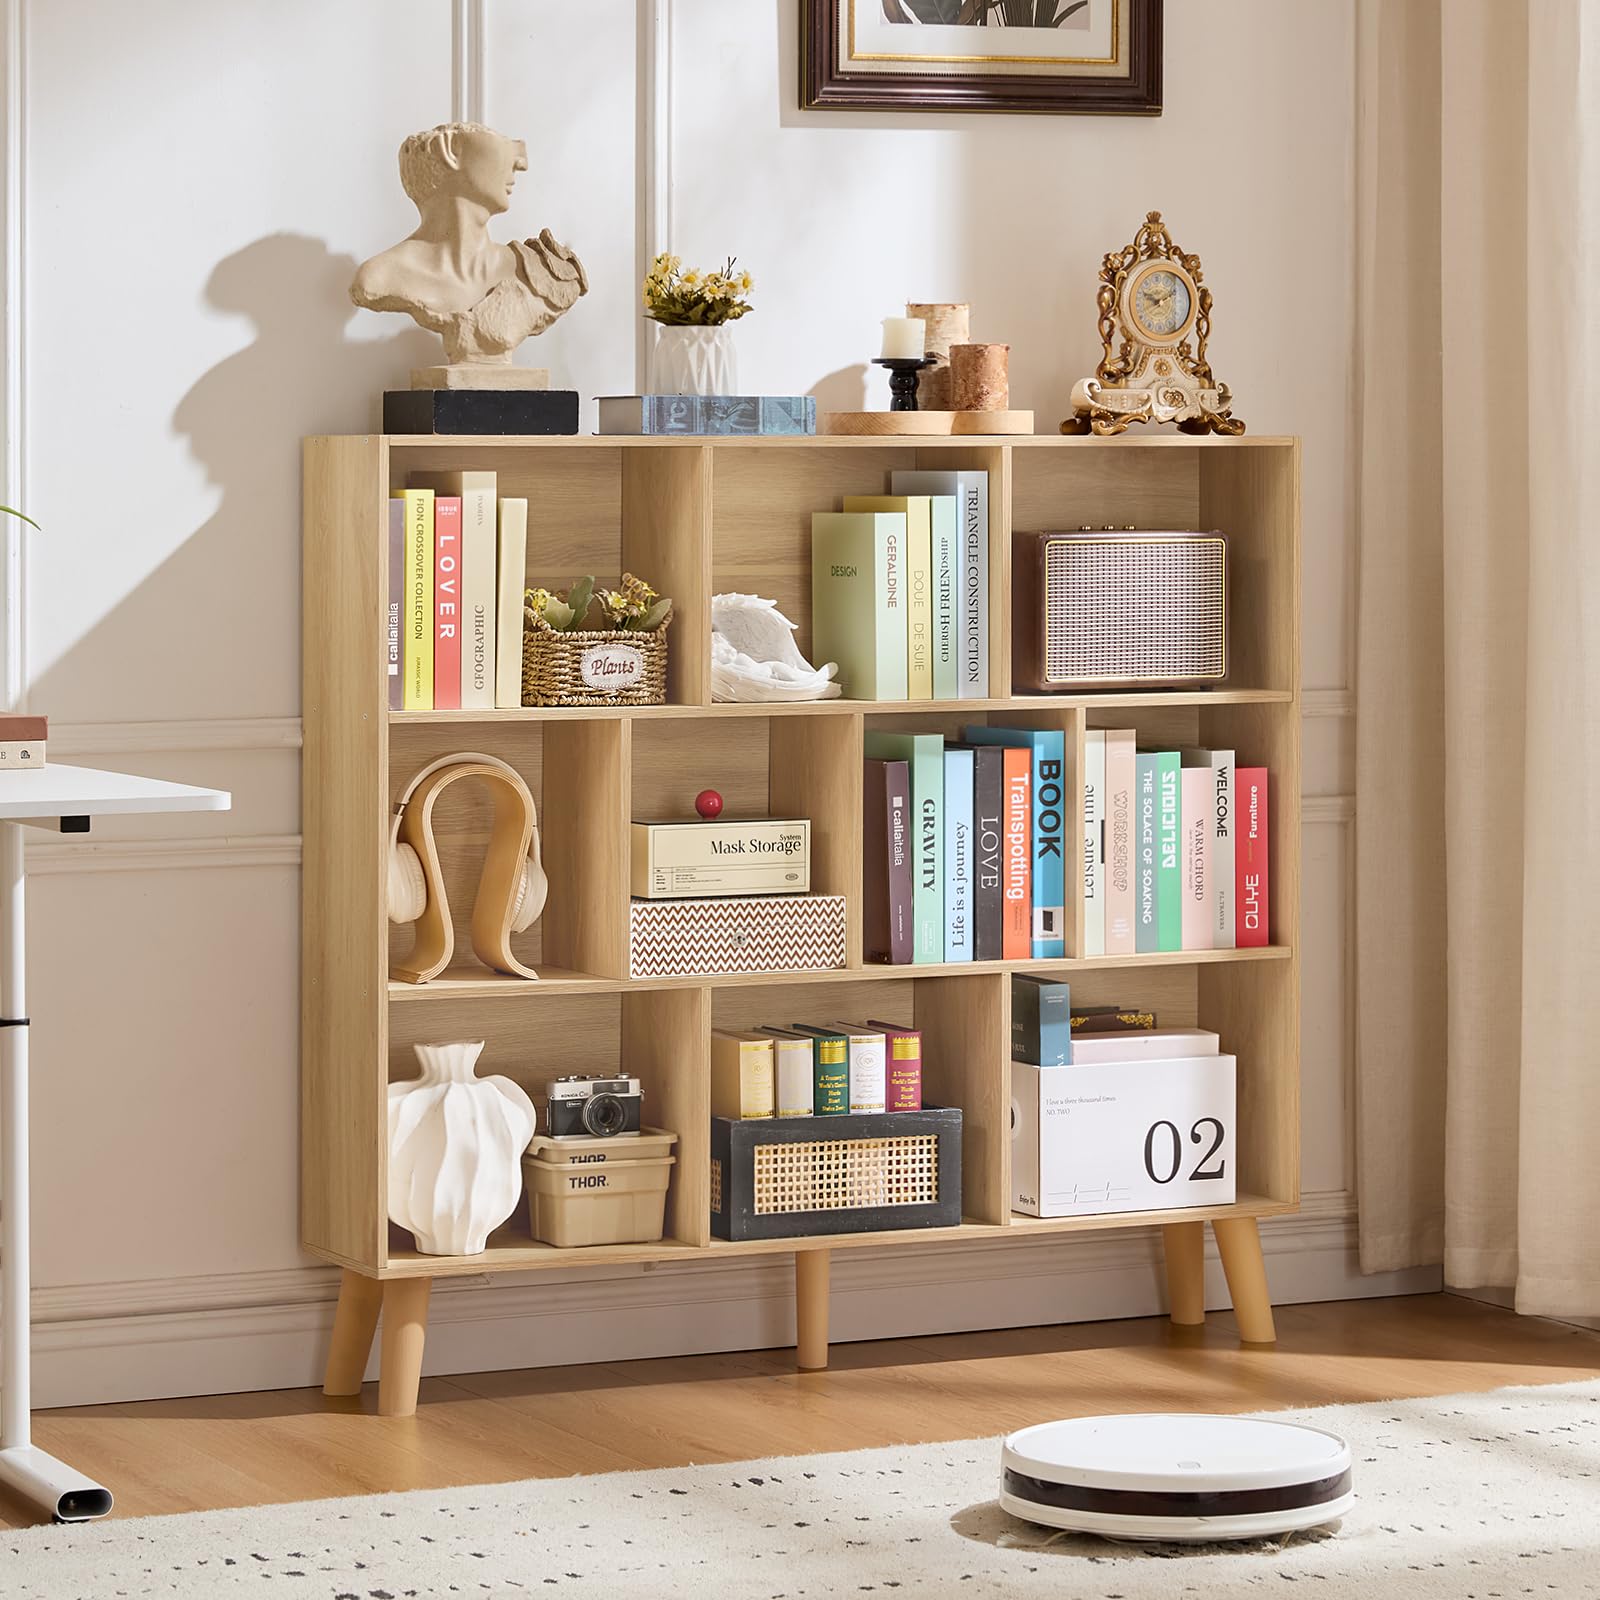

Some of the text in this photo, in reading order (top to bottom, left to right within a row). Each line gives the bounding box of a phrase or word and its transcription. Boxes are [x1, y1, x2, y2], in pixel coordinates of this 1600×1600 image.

[415, 498, 424, 640] FION CROSSOVER COLLECTION
[439, 535, 456, 639] LOVER
[831, 566, 857, 577] DESIGN
[887, 534, 897, 608] GERALDINE
[940, 537, 950, 663] CHERISH FRIENDSHIP
[968, 487, 979, 683] TRIANGLE CONSTRUCTION
[591, 656, 635, 676] Plants
[914, 623, 924, 640] DE
[914, 644, 924, 671] SUIE
[780, 834, 801, 842] System
[1038, 760, 1061, 859] BOOK
[1113, 790, 1128, 892] WORKSHOP
[1162, 770, 1176, 868] DELICIOUS
[1216, 766, 1227, 838] WELCOME
[1249, 785, 1258, 839] Furniture
[711, 838, 801, 855] Mask Storage
[922, 798, 936, 892] GRAVITY
[980, 816, 999, 889] LOVE
[1143, 770, 1152, 924] THE SOLACE OF SOAKING
[1195, 819, 1204, 901] WARM CHORD
[952, 822, 968, 947] Life is a journey
[1144, 1117, 1225, 1184] 02
